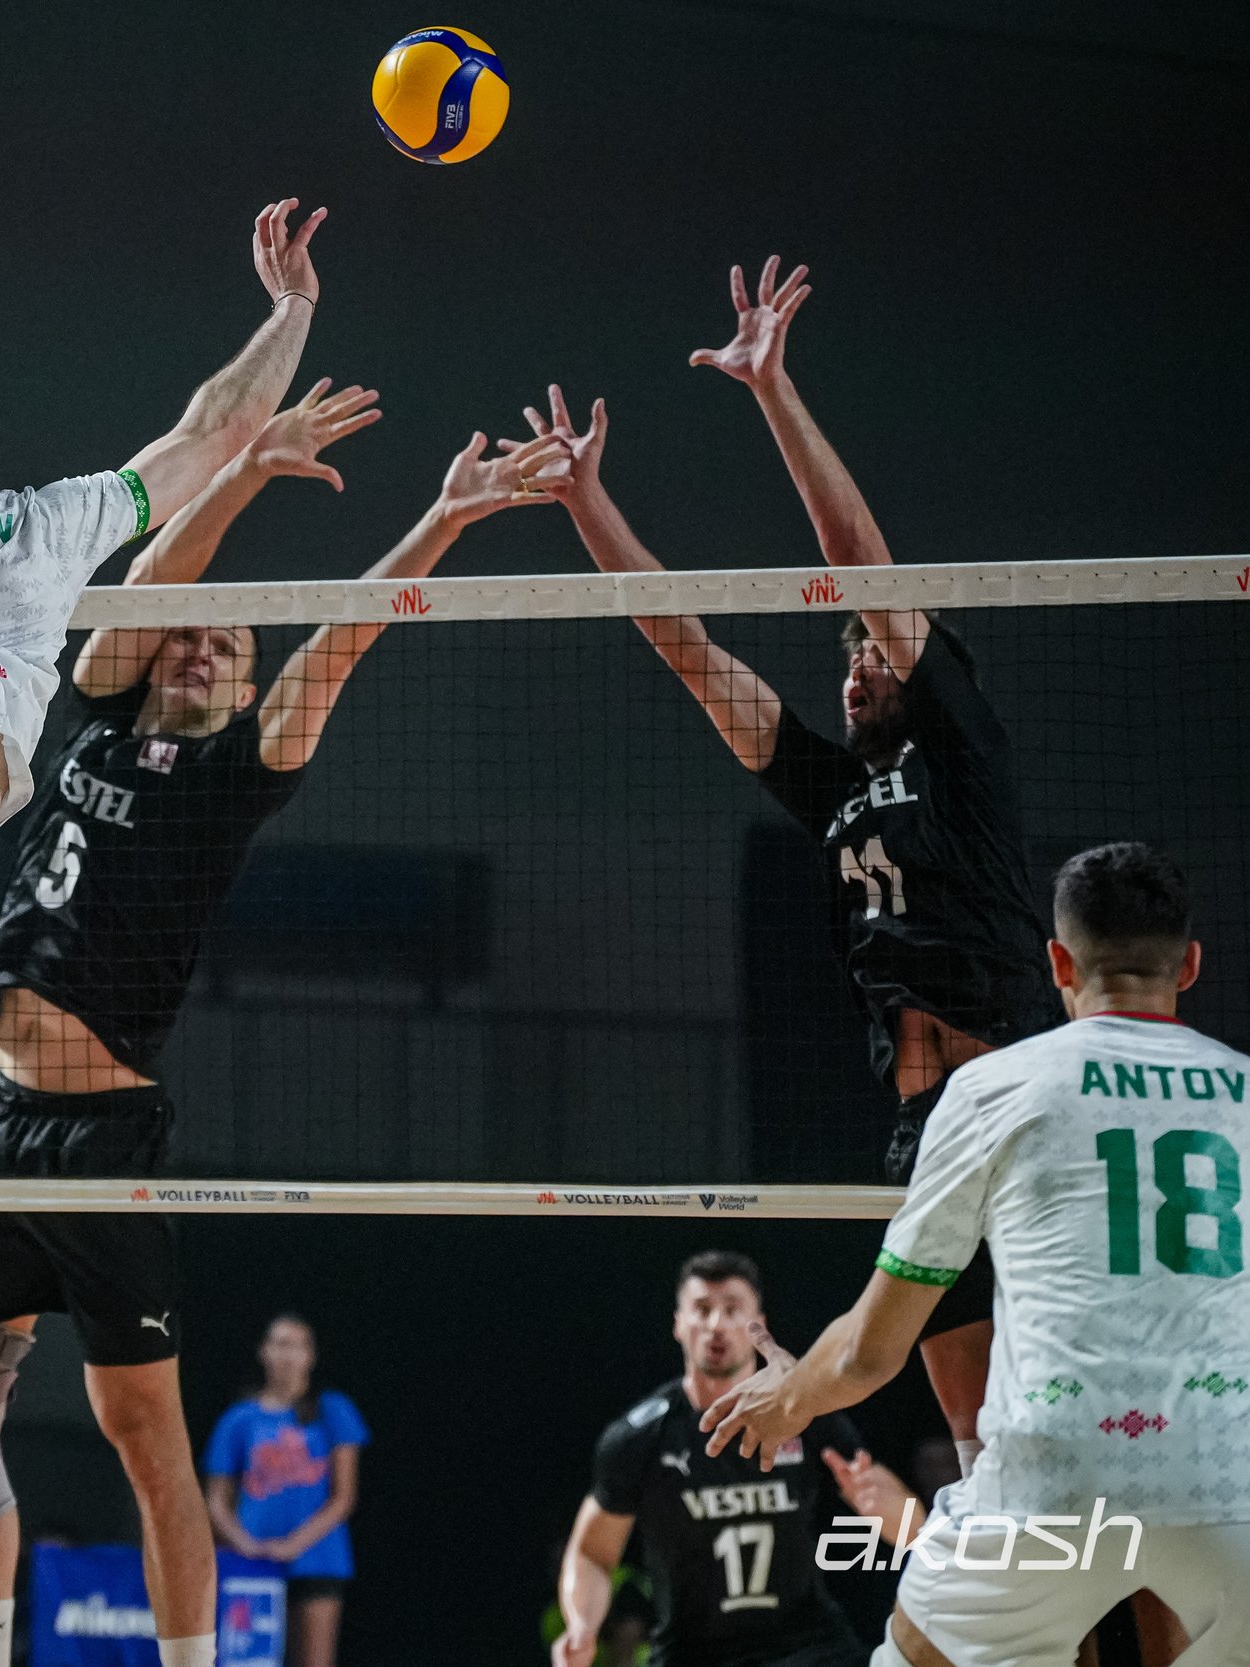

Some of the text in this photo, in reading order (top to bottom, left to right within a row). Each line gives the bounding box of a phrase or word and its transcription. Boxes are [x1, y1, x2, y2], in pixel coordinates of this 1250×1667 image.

[445, 104, 456, 129] FIVB
[35, 821, 88, 909] 5
[1081, 1061, 1245, 1103] ANTOV
[157, 1190, 247, 1201] VOLLEYBALL
[564, 1194, 659, 1205] VOLLEYBALL
[1096, 1128, 1244, 1279] 18
[681, 1481, 799, 1519] VESTEL
[713, 1523, 775, 1597] 17
